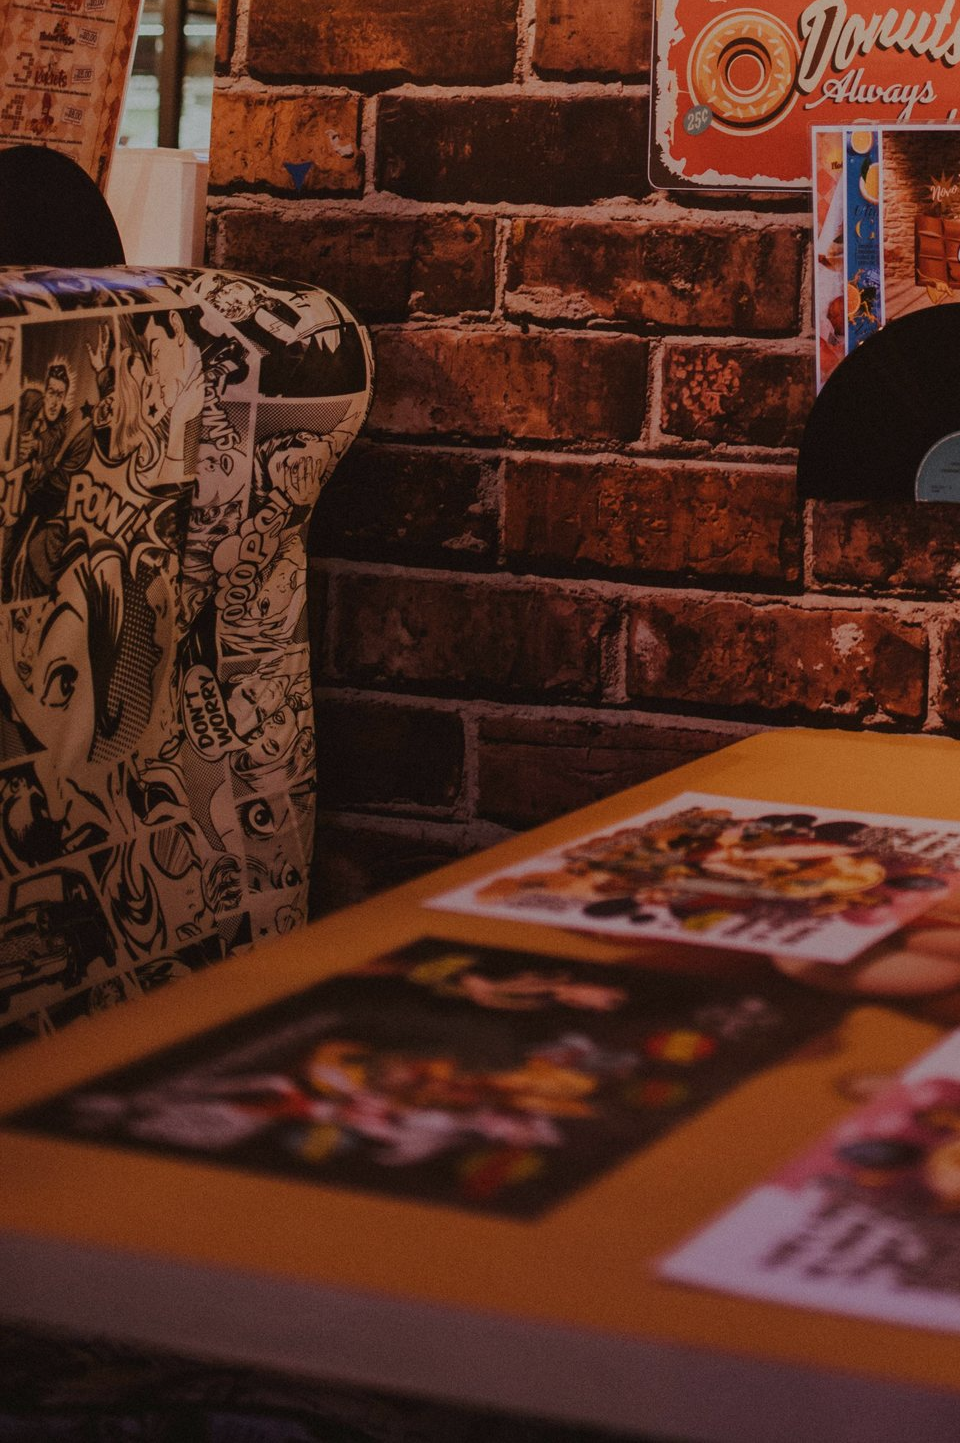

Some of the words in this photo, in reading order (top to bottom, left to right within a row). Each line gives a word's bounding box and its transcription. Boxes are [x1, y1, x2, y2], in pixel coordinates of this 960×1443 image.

[804, 68, 937, 123] Always
[930, 182, 959, 203] Novo
[66, 469, 153, 544] POW!
[184, 689, 214, 749] DON'T
[199, 675, 233, 748] WORRY
